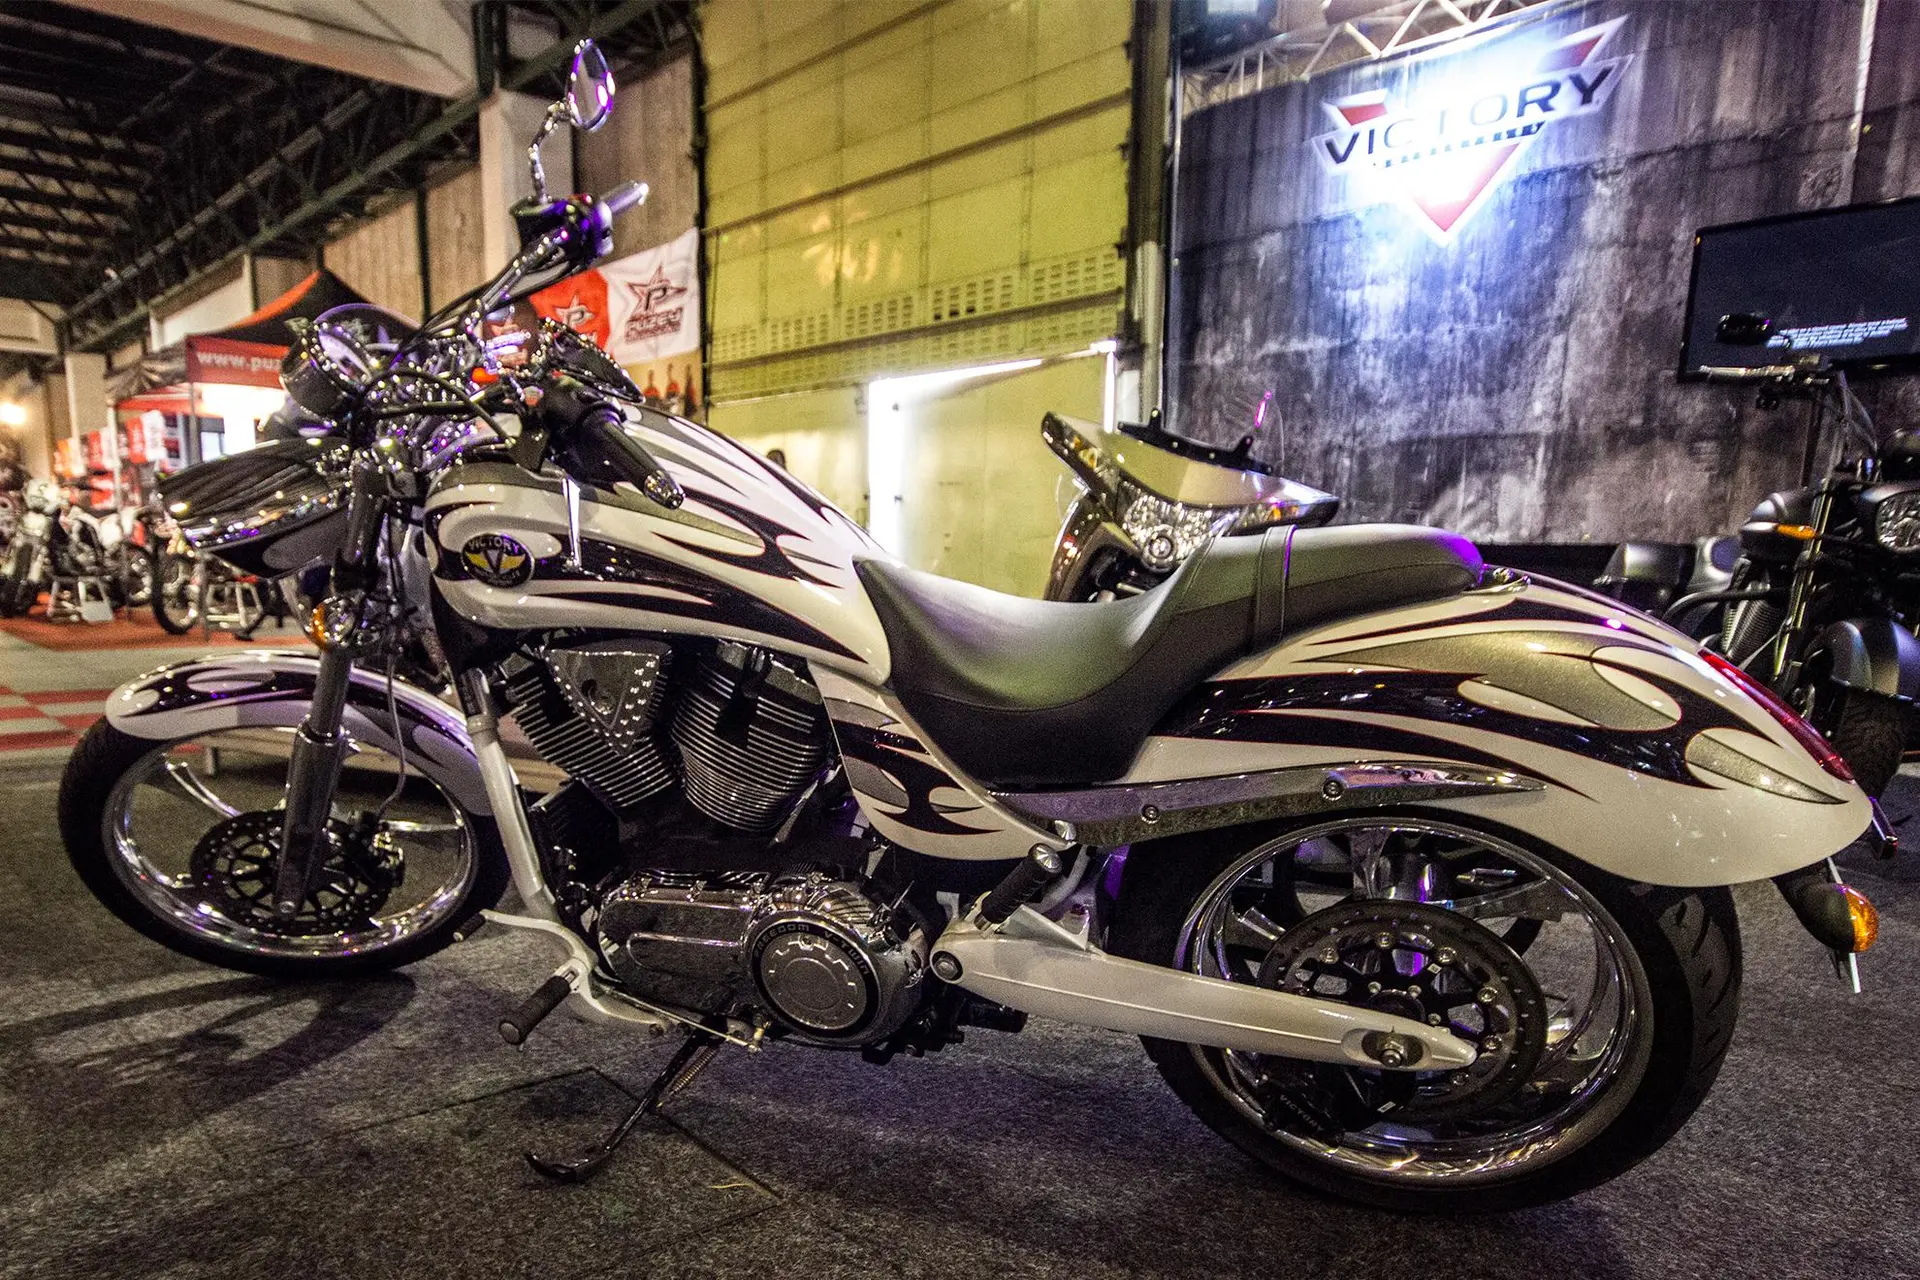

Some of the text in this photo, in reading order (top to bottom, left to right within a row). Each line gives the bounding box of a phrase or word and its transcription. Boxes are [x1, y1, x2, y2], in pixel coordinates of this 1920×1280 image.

[1325, 66, 1613, 164] VICTORY
[467, 536, 520, 554] VICTORY
[754, 924, 871, 975] FREEDOM V-TWIN
